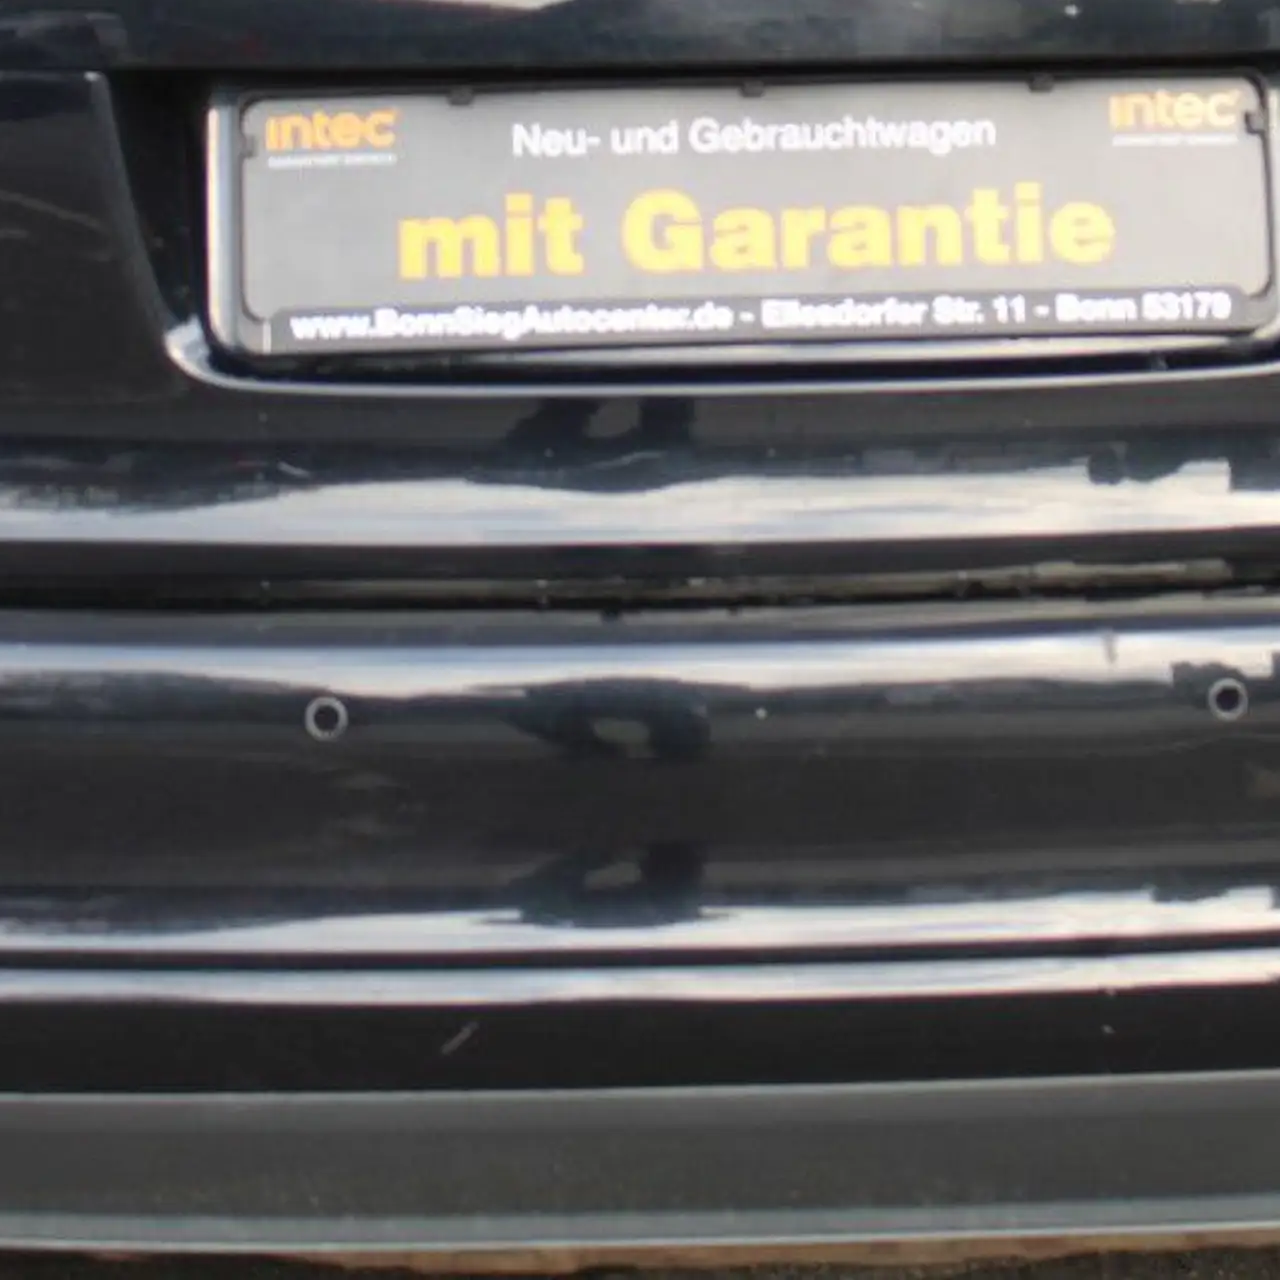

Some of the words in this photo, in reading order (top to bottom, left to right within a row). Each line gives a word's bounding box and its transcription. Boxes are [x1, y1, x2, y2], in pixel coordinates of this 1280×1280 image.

[512, 122, 601, 157] Neu-
[610, 119, 679, 155] und
[688, 115, 996, 156] Gebrauchtwagen
[399, 192, 585, 279] mit
[623, 181, 1116, 273] Garantie
[931, 294, 984, 326] Str.
[992, 294, 1027, 322] 11
[1055, 292, 1137, 322] Bonn
